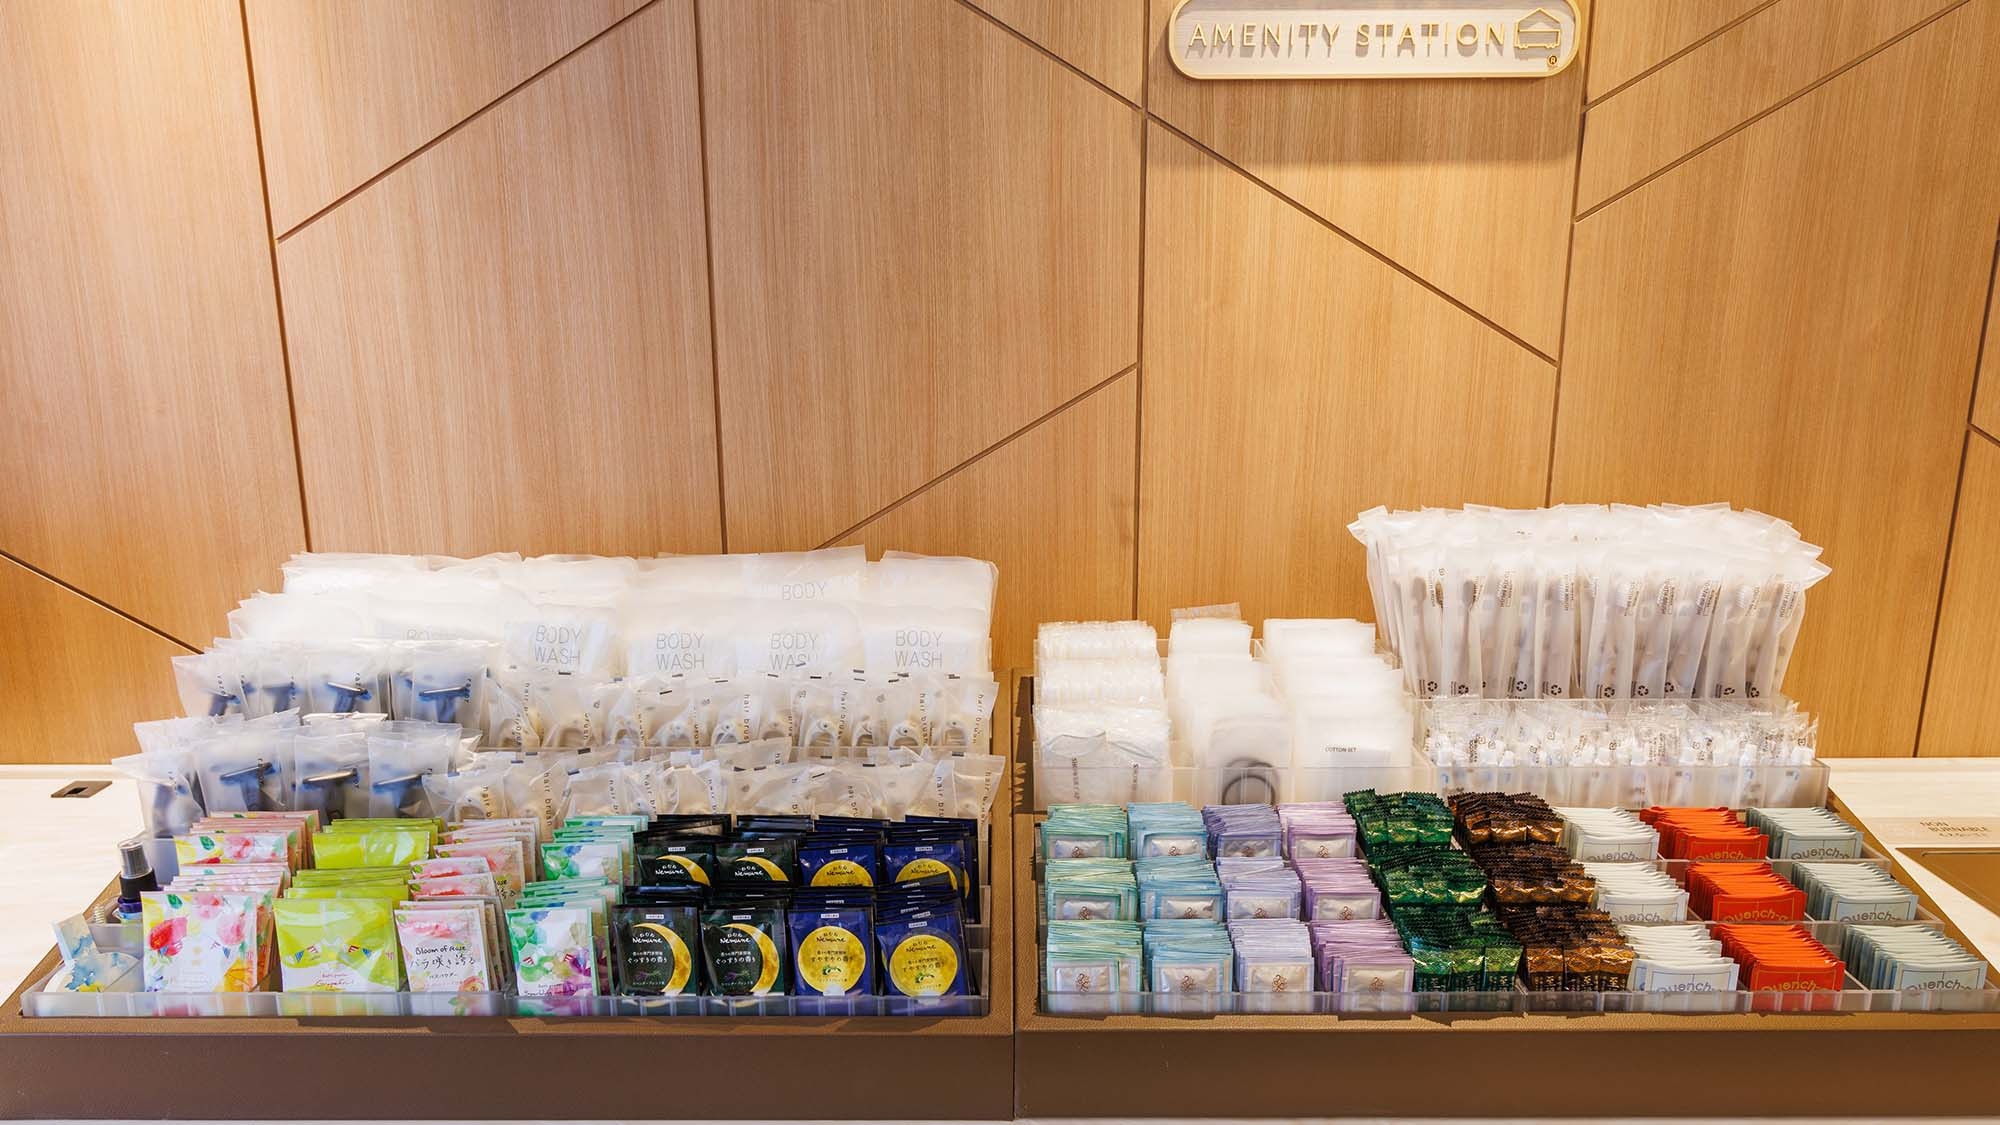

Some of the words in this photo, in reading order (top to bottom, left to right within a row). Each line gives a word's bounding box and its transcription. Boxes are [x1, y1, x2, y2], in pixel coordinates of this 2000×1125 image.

[1188, 23, 1341, 47] AMENITY
[1356, 23, 1505, 47] STATION
[782, 583, 826, 600] BODY
[535, 625, 583, 644] BODY
[656, 633, 705, 650] BODY
[771, 632, 819, 650] BODY
[895, 630, 944, 648] BODY
[534, 647, 582, 665] WASH
[656, 653, 705, 670] WASH
[770, 654, 818, 670] WAS
[895, 651, 943, 668] WASH
[743, 718, 751, 741] brus
[415, 946, 439, 955] Bloom
